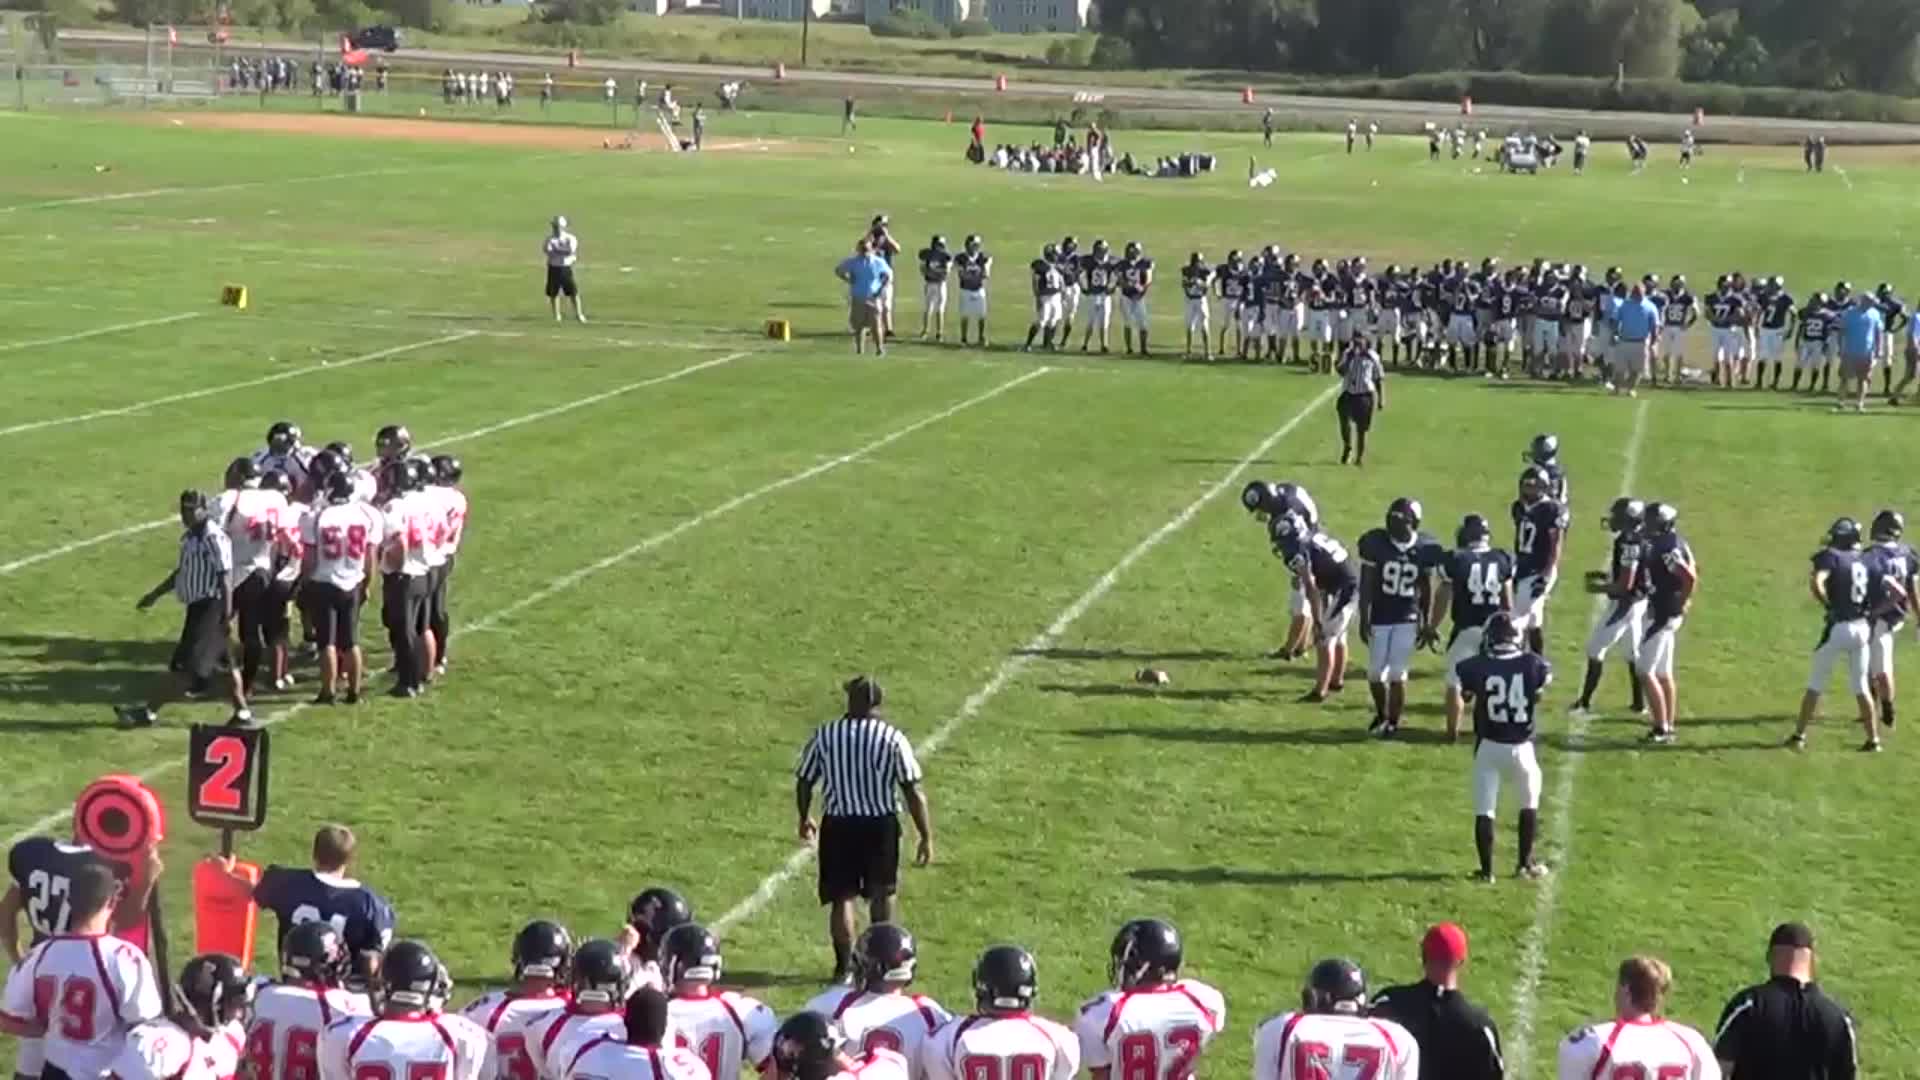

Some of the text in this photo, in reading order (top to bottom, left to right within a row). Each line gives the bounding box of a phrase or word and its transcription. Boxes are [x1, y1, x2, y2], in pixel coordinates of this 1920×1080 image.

[321, 524, 367, 560] 58
[1382, 561, 1419, 597] 92
[1468, 563, 1502, 605] 44
[1851, 561, 1868, 603] 8
[1486, 674, 1529, 723] 24
[200, 736, 246, 809] 2
[28, 869, 72, 937] 27
[1120, 1024, 1200, 1080] 82
